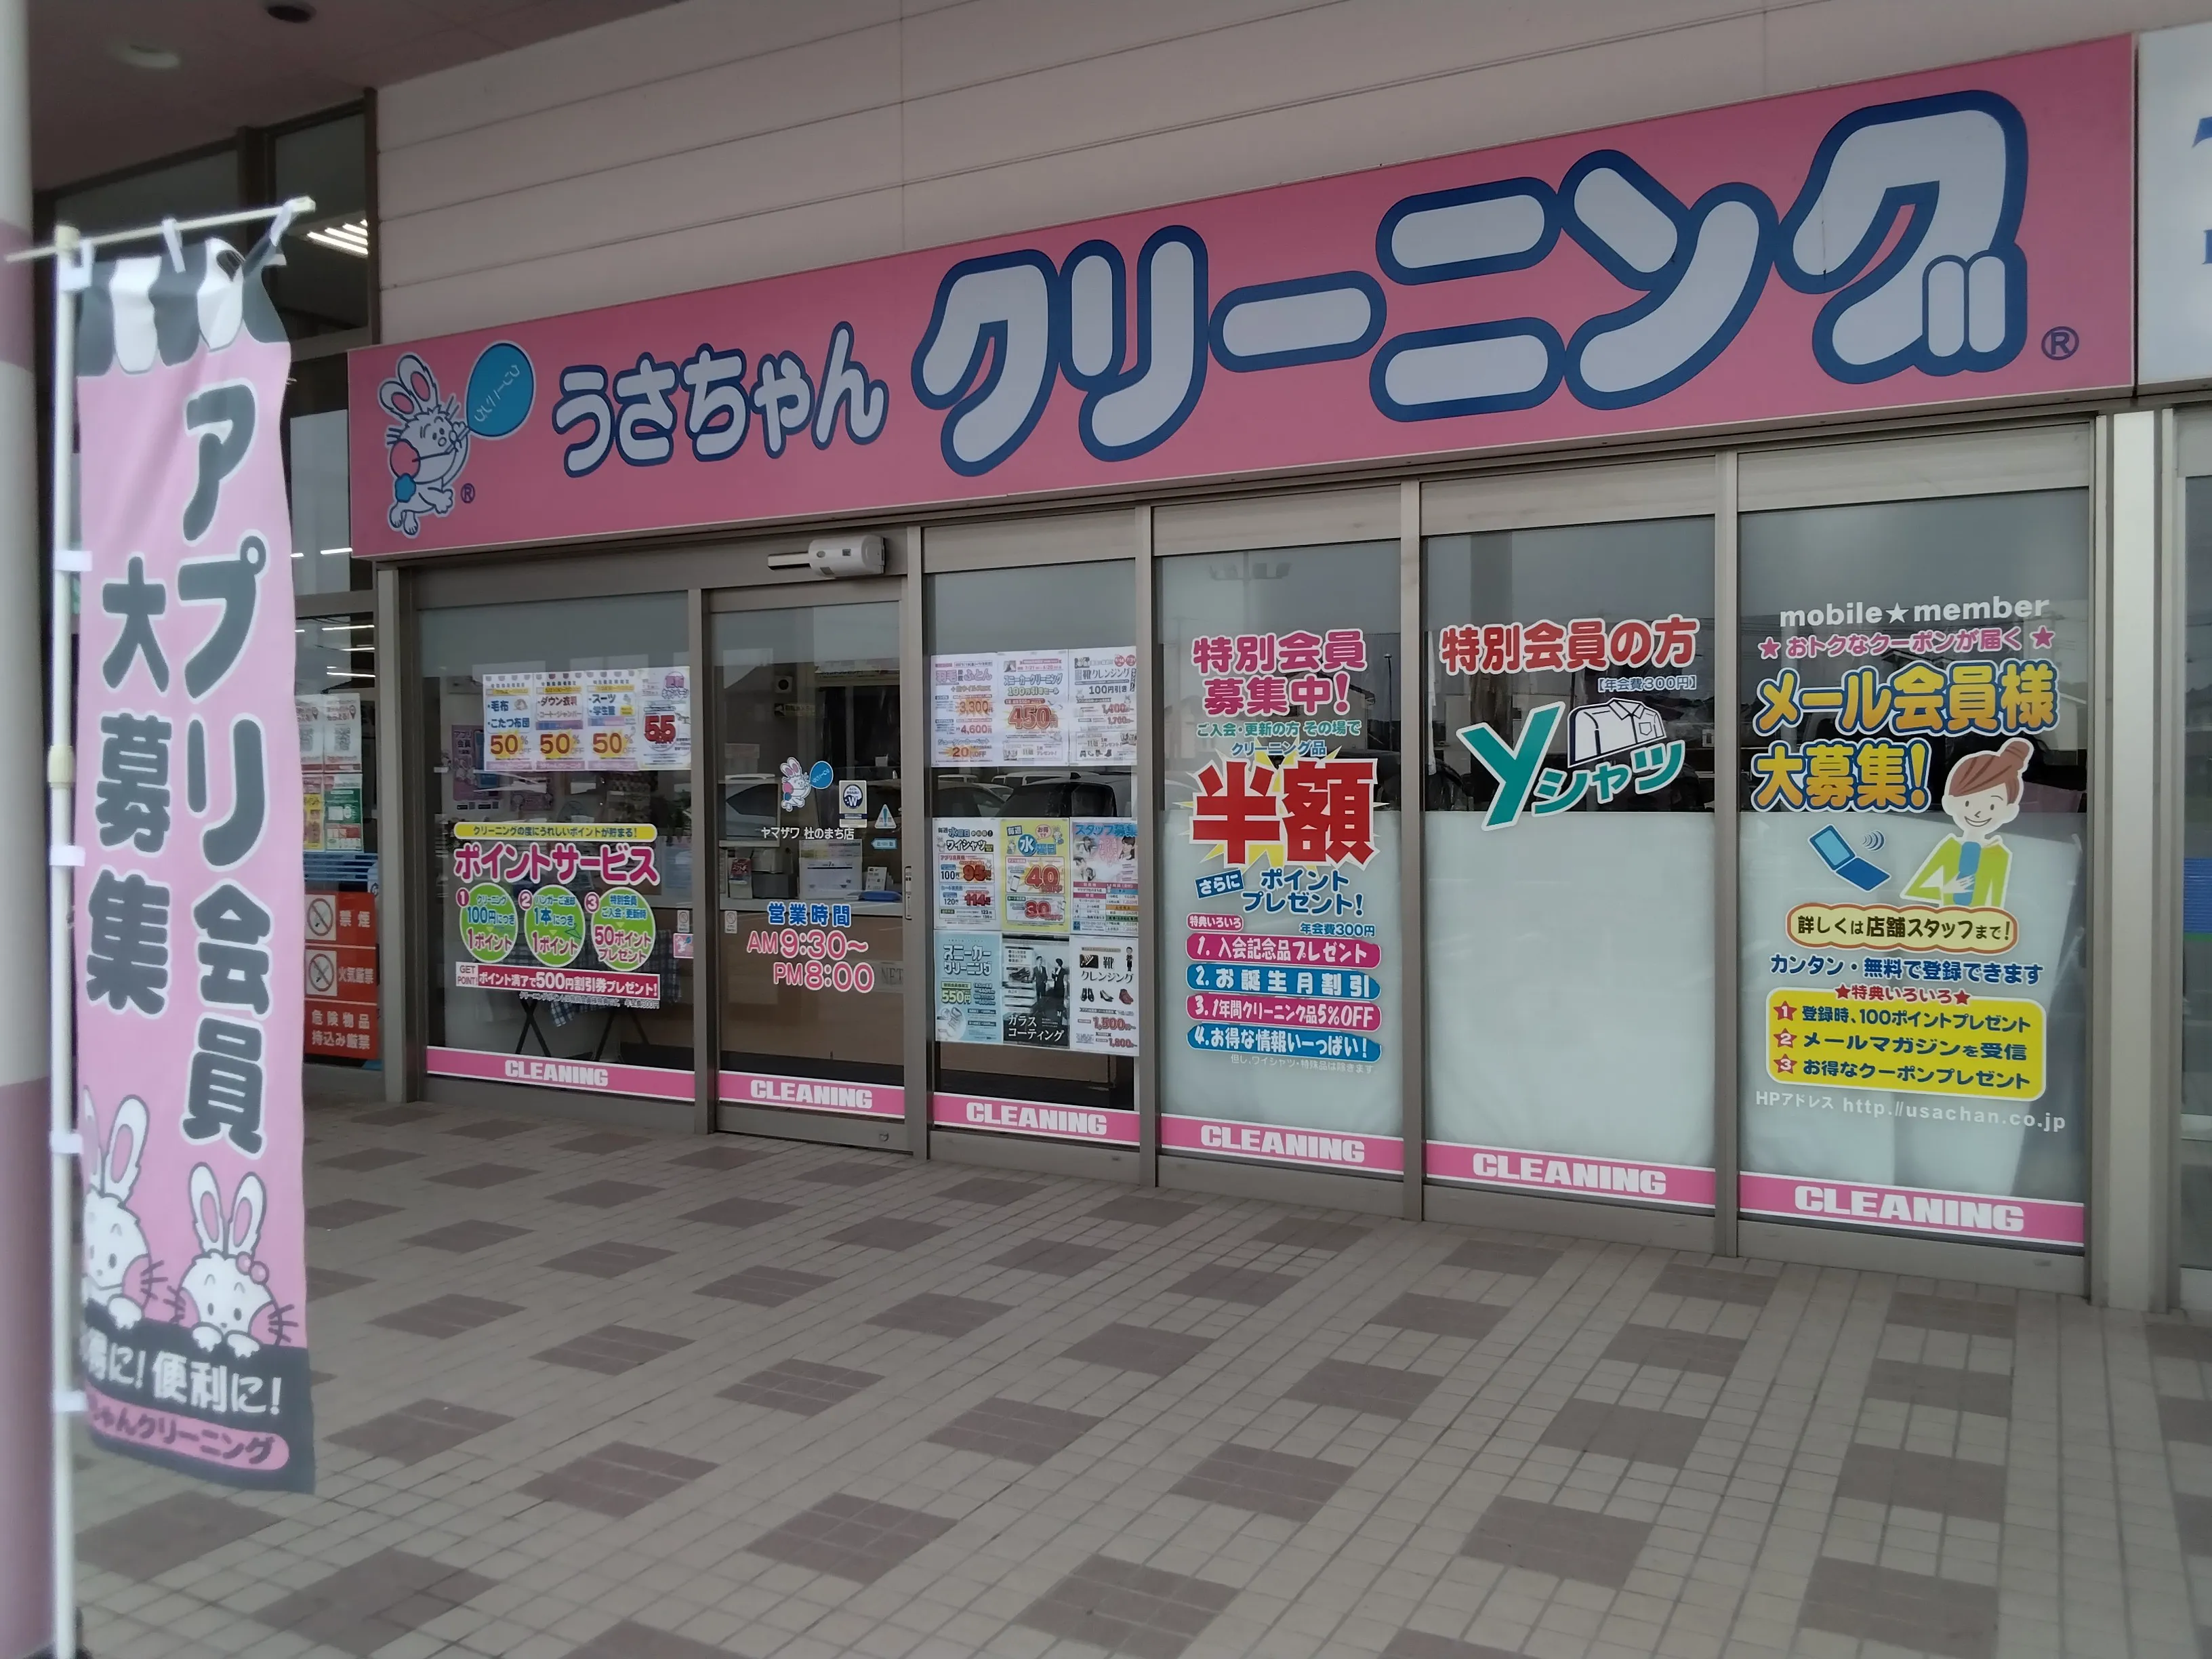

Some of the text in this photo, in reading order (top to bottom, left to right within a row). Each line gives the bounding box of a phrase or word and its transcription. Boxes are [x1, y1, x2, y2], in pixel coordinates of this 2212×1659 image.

[912, 89, 2028, 476] クリーニング
[553, 321, 889, 478] うさちゃん
[1191, 629, 1366, 675] 特別会員
[1439, 614, 1699, 676] 特別会員の方
[1004, 673, 1063, 686] スニーカークリーニング
[1203, 672, 1351, 716] 募集中!
[1753, 658, 2060, 736] メール会員様
[1008, 705, 1059, 729] 450円
[1196, 720, 1361, 738] ご入会・更新の方 その場で
[1231, 739, 1326, 757] クリーニング品
[178, 378, 272, 1158] アプリ会員
[1456, 701, 1685, 831] Yシャツ
[1751, 737, 1932, 813] 大募集!
[85, 553, 172, 1017] 大募集
[1189, 758, 1378, 868] 半額
[760, 827, 855, 840] ヤマザワ 杜のまち店
[946, 839, 987, 851] ワイシャツ
[453, 842, 660, 885] ポイントサービス
[1198, 868, 1349, 895] さらに ポイント
[477, 895, 508, 905] クリーニング
[1242, 893, 1364, 916] プレゼント!
[339, 911, 370, 928] 禁煙
[767, 902, 852, 927] 営業時間
[1189, 916, 1242, 928] 特典いろいろ
[467, 927, 512, 951] 1ポイント
[594, 925, 651, 947] 50ポイント
[1299, 922, 1376, 937] 年会費300円
[1797, 915, 2010, 941] 詳しくは店舗スタッフまで!
[532, 930, 578, 956] 1ポイント
[943, 944, 991, 961] スニーカー
[598, 949, 646, 963] プレゼント
[944, 961, 992, 976] クリーニング
[1103, 956, 1114, 969] 靴
[459, 965, 475, 975] GET
[1081, 970, 1134, 983] クレンジング
[1770, 954, 2044, 985] カンタン・無料で登録できます
[941, 989, 971, 1004] 550円
[312, 1010, 370, 1029] 危険物品
[1008, 1014, 1037, 1027] ガラス
[312, 1030, 370, 1050] 持込み厳禁
[1008, 1027, 1065, 1042] コーティング
[1803, 1032, 2027, 1061] メールマガジンを受信
[504, 1059, 609, 1087] CLEANING
[1803, 1059, 2030, 1089] お得なクーポンプレゼント
[750, 1079, 872, 1110] CLEANING
[1756, 1090, 1834, 1110] HPアドレス
[966, 1102, 1107, 1136] CLEANING
[1200, 1125, 1366, 1164] CLEANING
[1472, 1152, 1667, 1196] CLEANING
[1795, 1185, 2024, 1233] CLEANING
[153, 1351, 282, 1416] 便利に!
